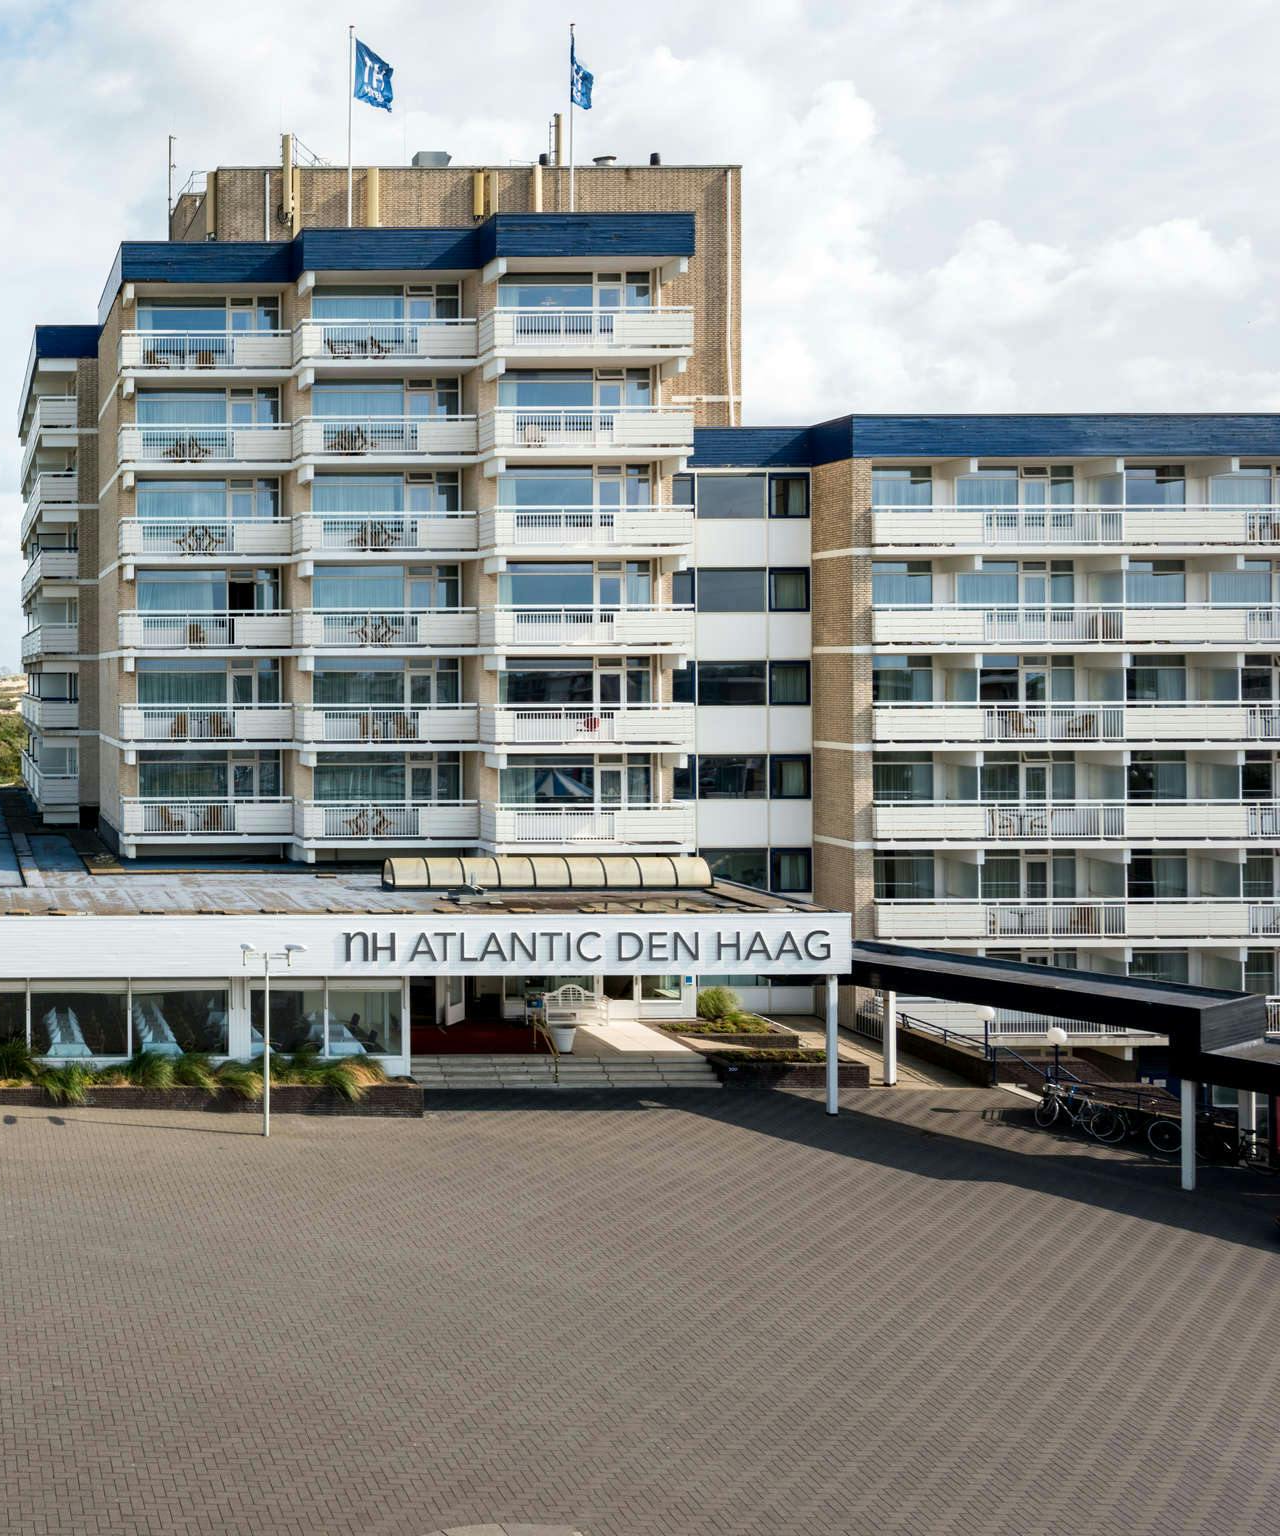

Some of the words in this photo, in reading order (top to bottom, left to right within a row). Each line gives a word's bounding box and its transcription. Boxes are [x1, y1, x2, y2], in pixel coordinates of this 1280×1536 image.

[409, 931, 602, 962] ATLANTIC
[617, 931, 700, 962] DEN
[716, 930, 832, 961] HAAG
